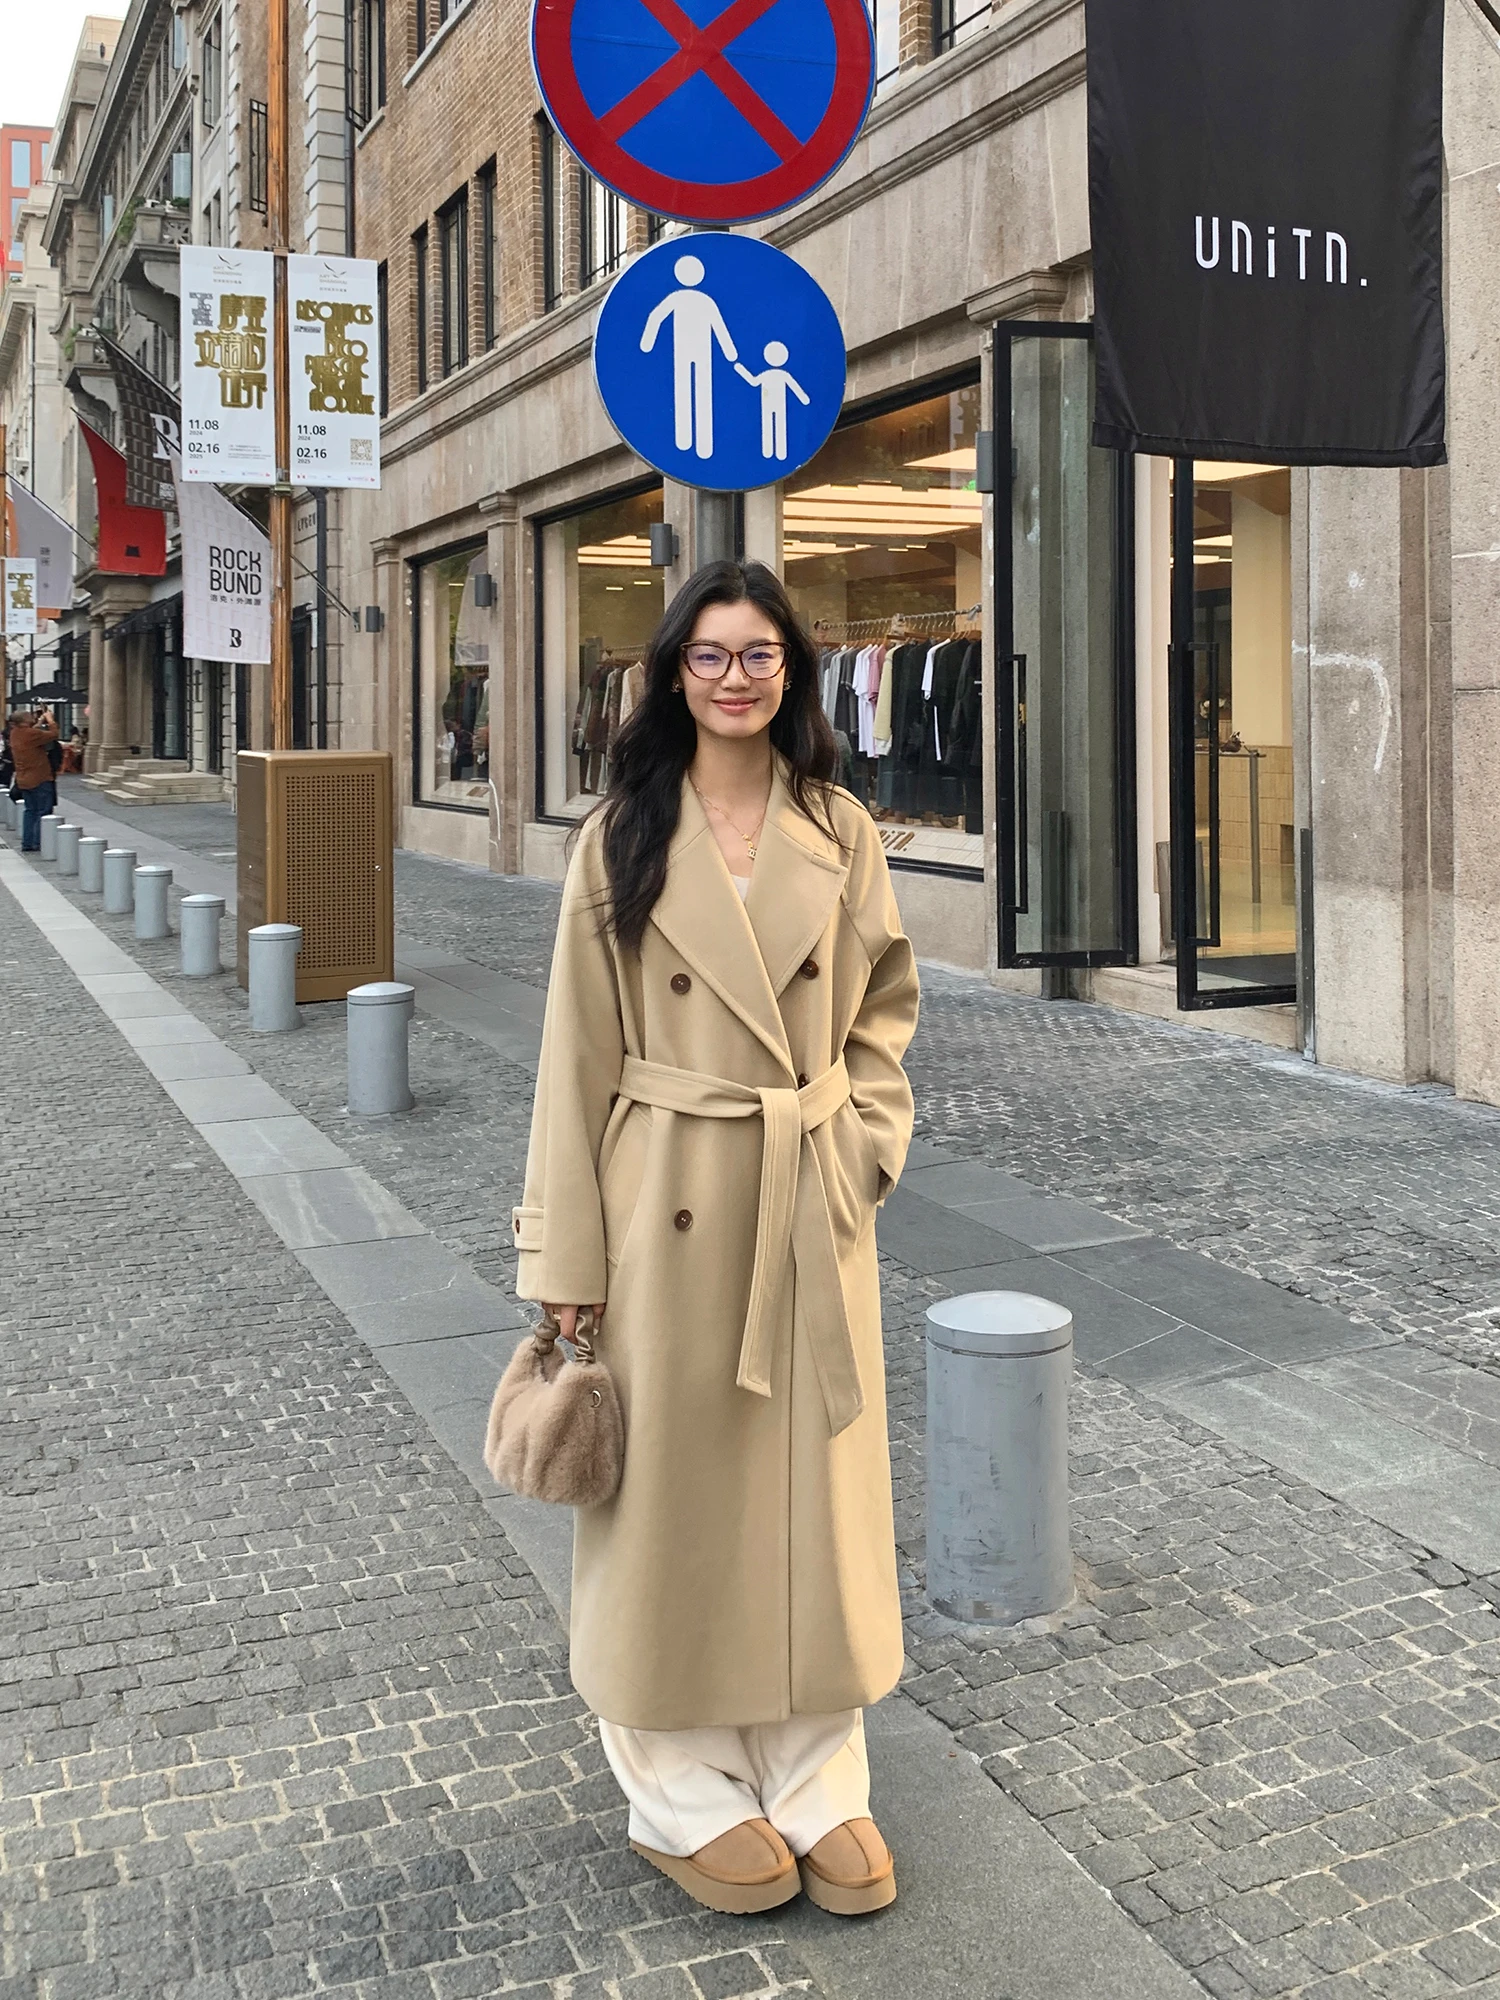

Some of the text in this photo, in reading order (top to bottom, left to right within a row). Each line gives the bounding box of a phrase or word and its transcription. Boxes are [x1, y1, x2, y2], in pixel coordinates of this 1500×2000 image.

[188, 419, 220, 431] 11.08
[297, 424, 327, 436] 11.08
[188, 442, 220, 454] 02.16
[296, 447, 328, 459] 02.16
[209, 545, 262, 573] ROCK
[210, 569, 262, 595] BUND
